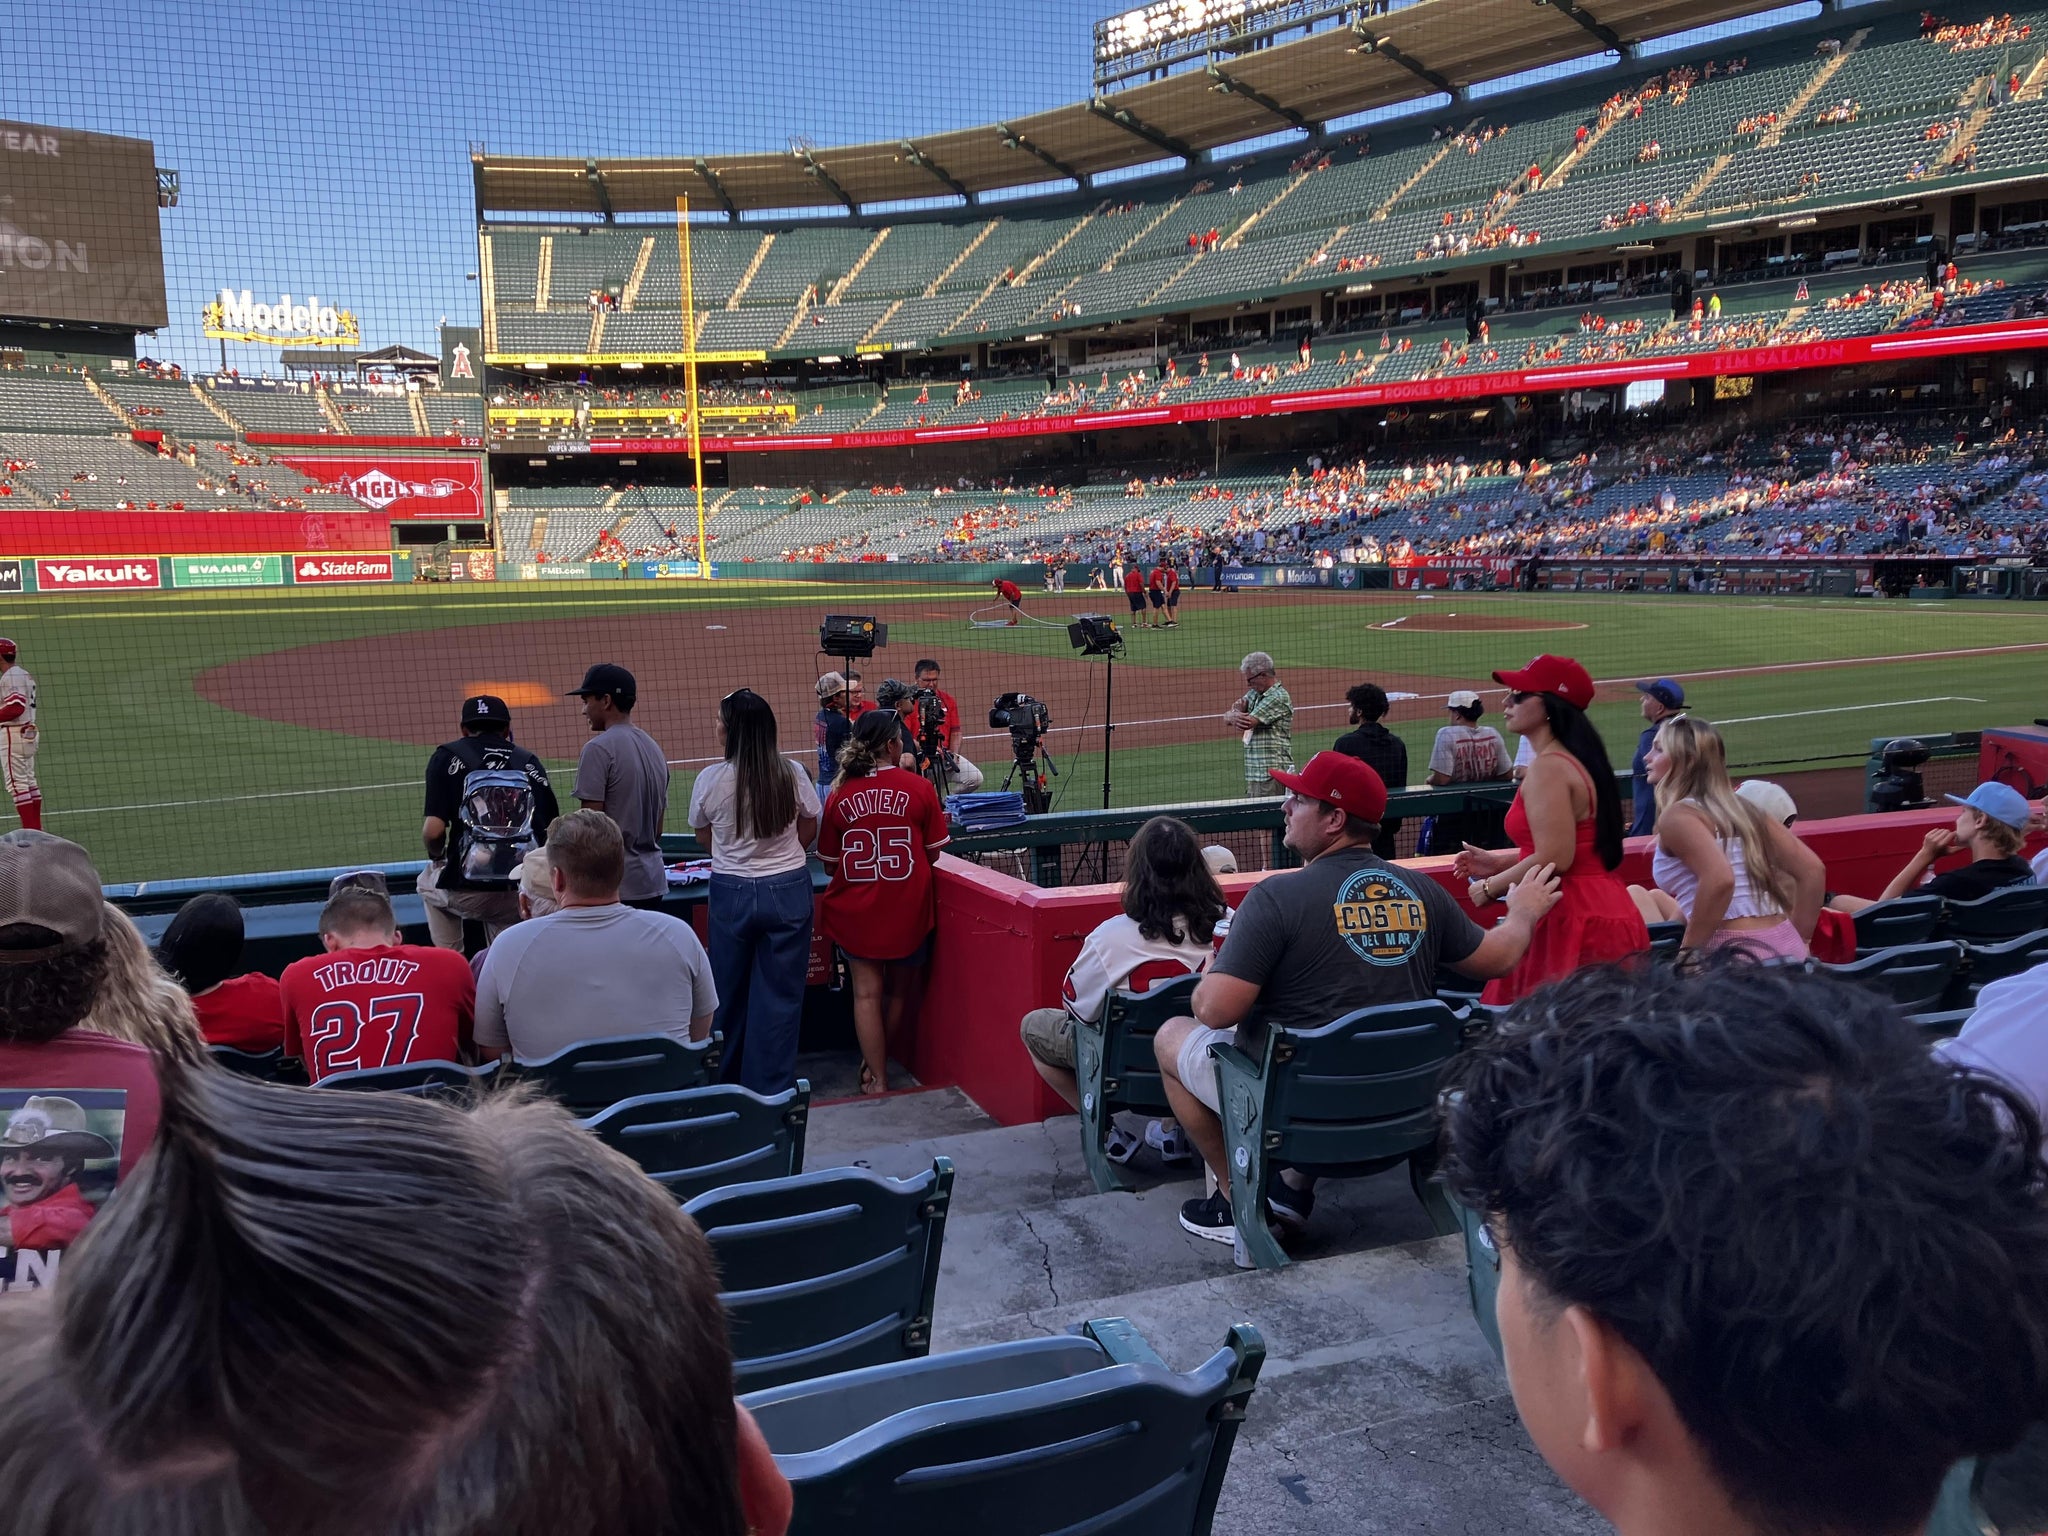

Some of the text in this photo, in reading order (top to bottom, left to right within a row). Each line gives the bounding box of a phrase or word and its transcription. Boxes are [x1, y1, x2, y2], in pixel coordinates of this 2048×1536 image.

[221, 288, 338, 336] Modelo
[1713, 344, 1845, 371] TIM SALMON
[1384, 374, 1520, 399] ROOKIE OF THE YEAR
[1183, 400, 1256, 418] TIM SALMON
[990, 418, 1071, 435] ROOKIE OF THE YEAR
[461, 438, 479, 446] 6:22
[625, 441, 663, 450] ROOKIE
[666, 441, 676, 450] OF
[703, 440, 730, 450] YEAR
[844, 432, 905, 445] TIM SALMON
[339, 477, 415, 499] ANGELS
[188, 564, 247, 574] EVA AIR
[541, 567, 584, 575] FMB.com
[1427, 559, 1482, 568] SALINAS
[45, 564, 153, 583] Yakult
[1287, 570, 1316, 584] Modelo
[477, 699, 488, 714] LA
[838, 789, 910, 823] MOYER
[841, 827, 914, 882] 25
[1341, 903, 1422, 929] COSTA
[1361, 932, 1411, 947] DEL MAR
[314, 957, 420, 993] TROUT
[310, 992, 425, 1082] 27
